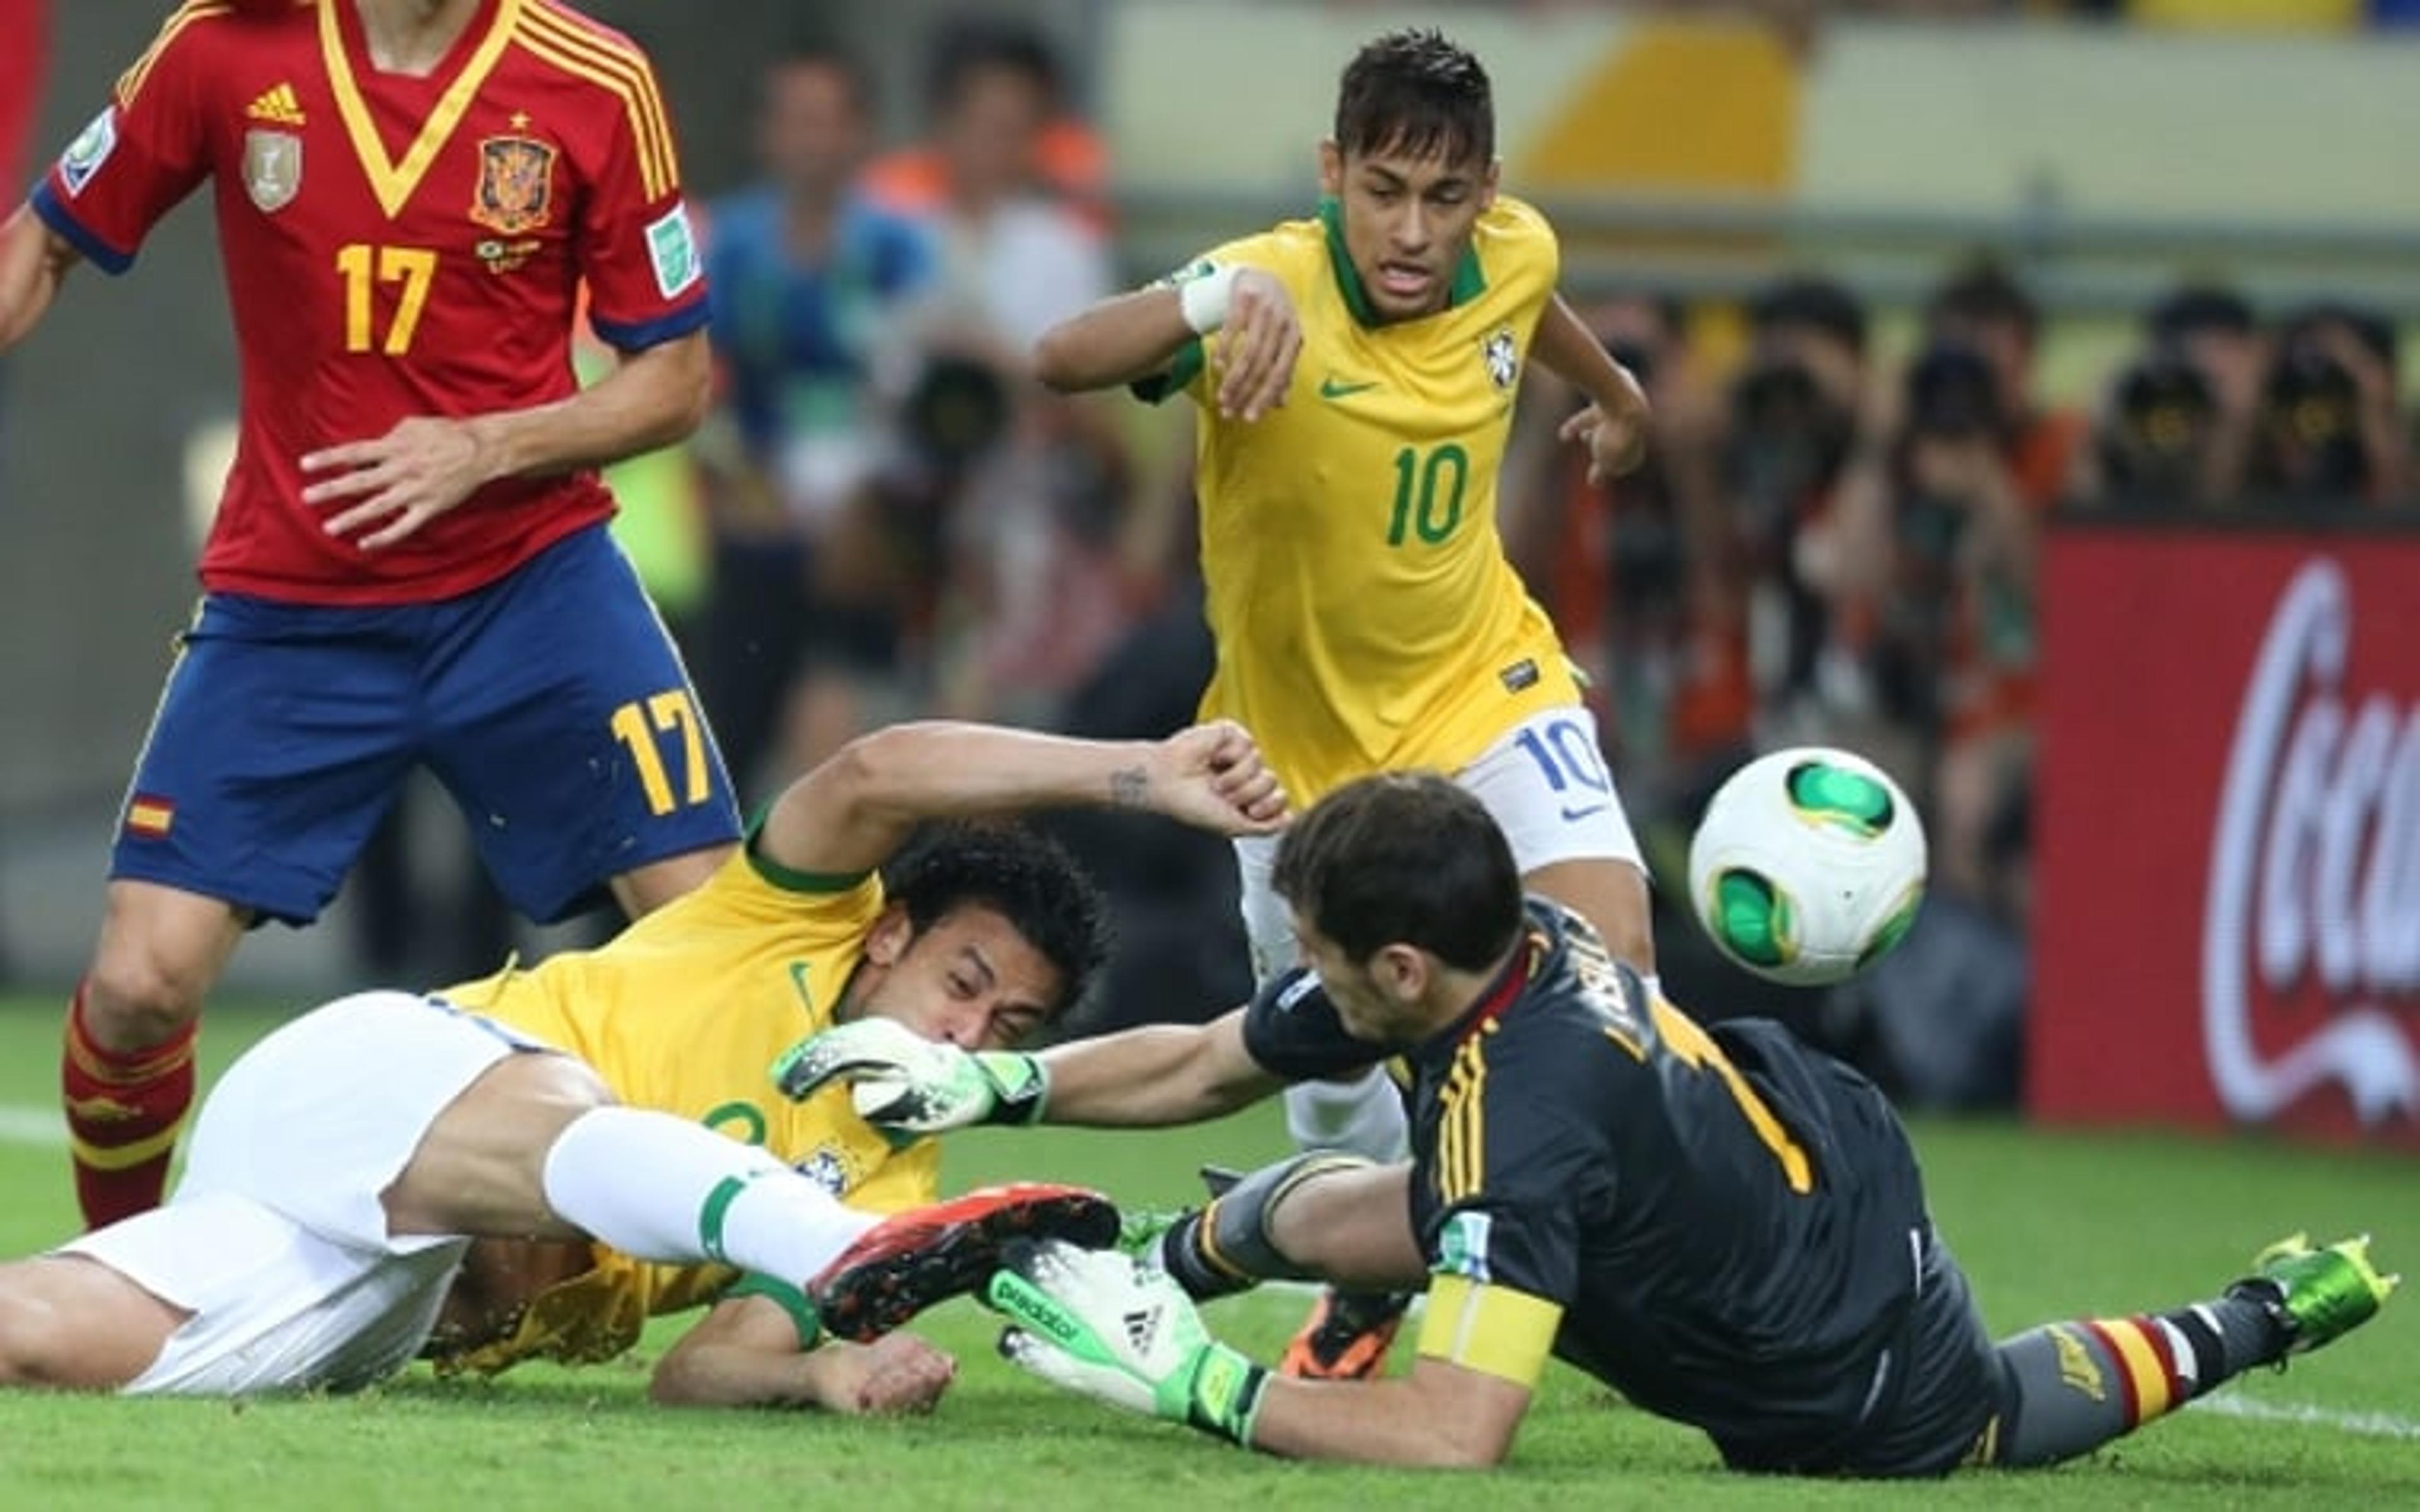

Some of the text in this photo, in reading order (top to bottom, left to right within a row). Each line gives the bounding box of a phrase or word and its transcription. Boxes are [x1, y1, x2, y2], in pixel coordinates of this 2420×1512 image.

[337, 243, 437, 356] 17
[1388, 444, 1468, 547] 10
[611, 689, 708, 815] 17
[1515, 720, 1610, 794] 10
